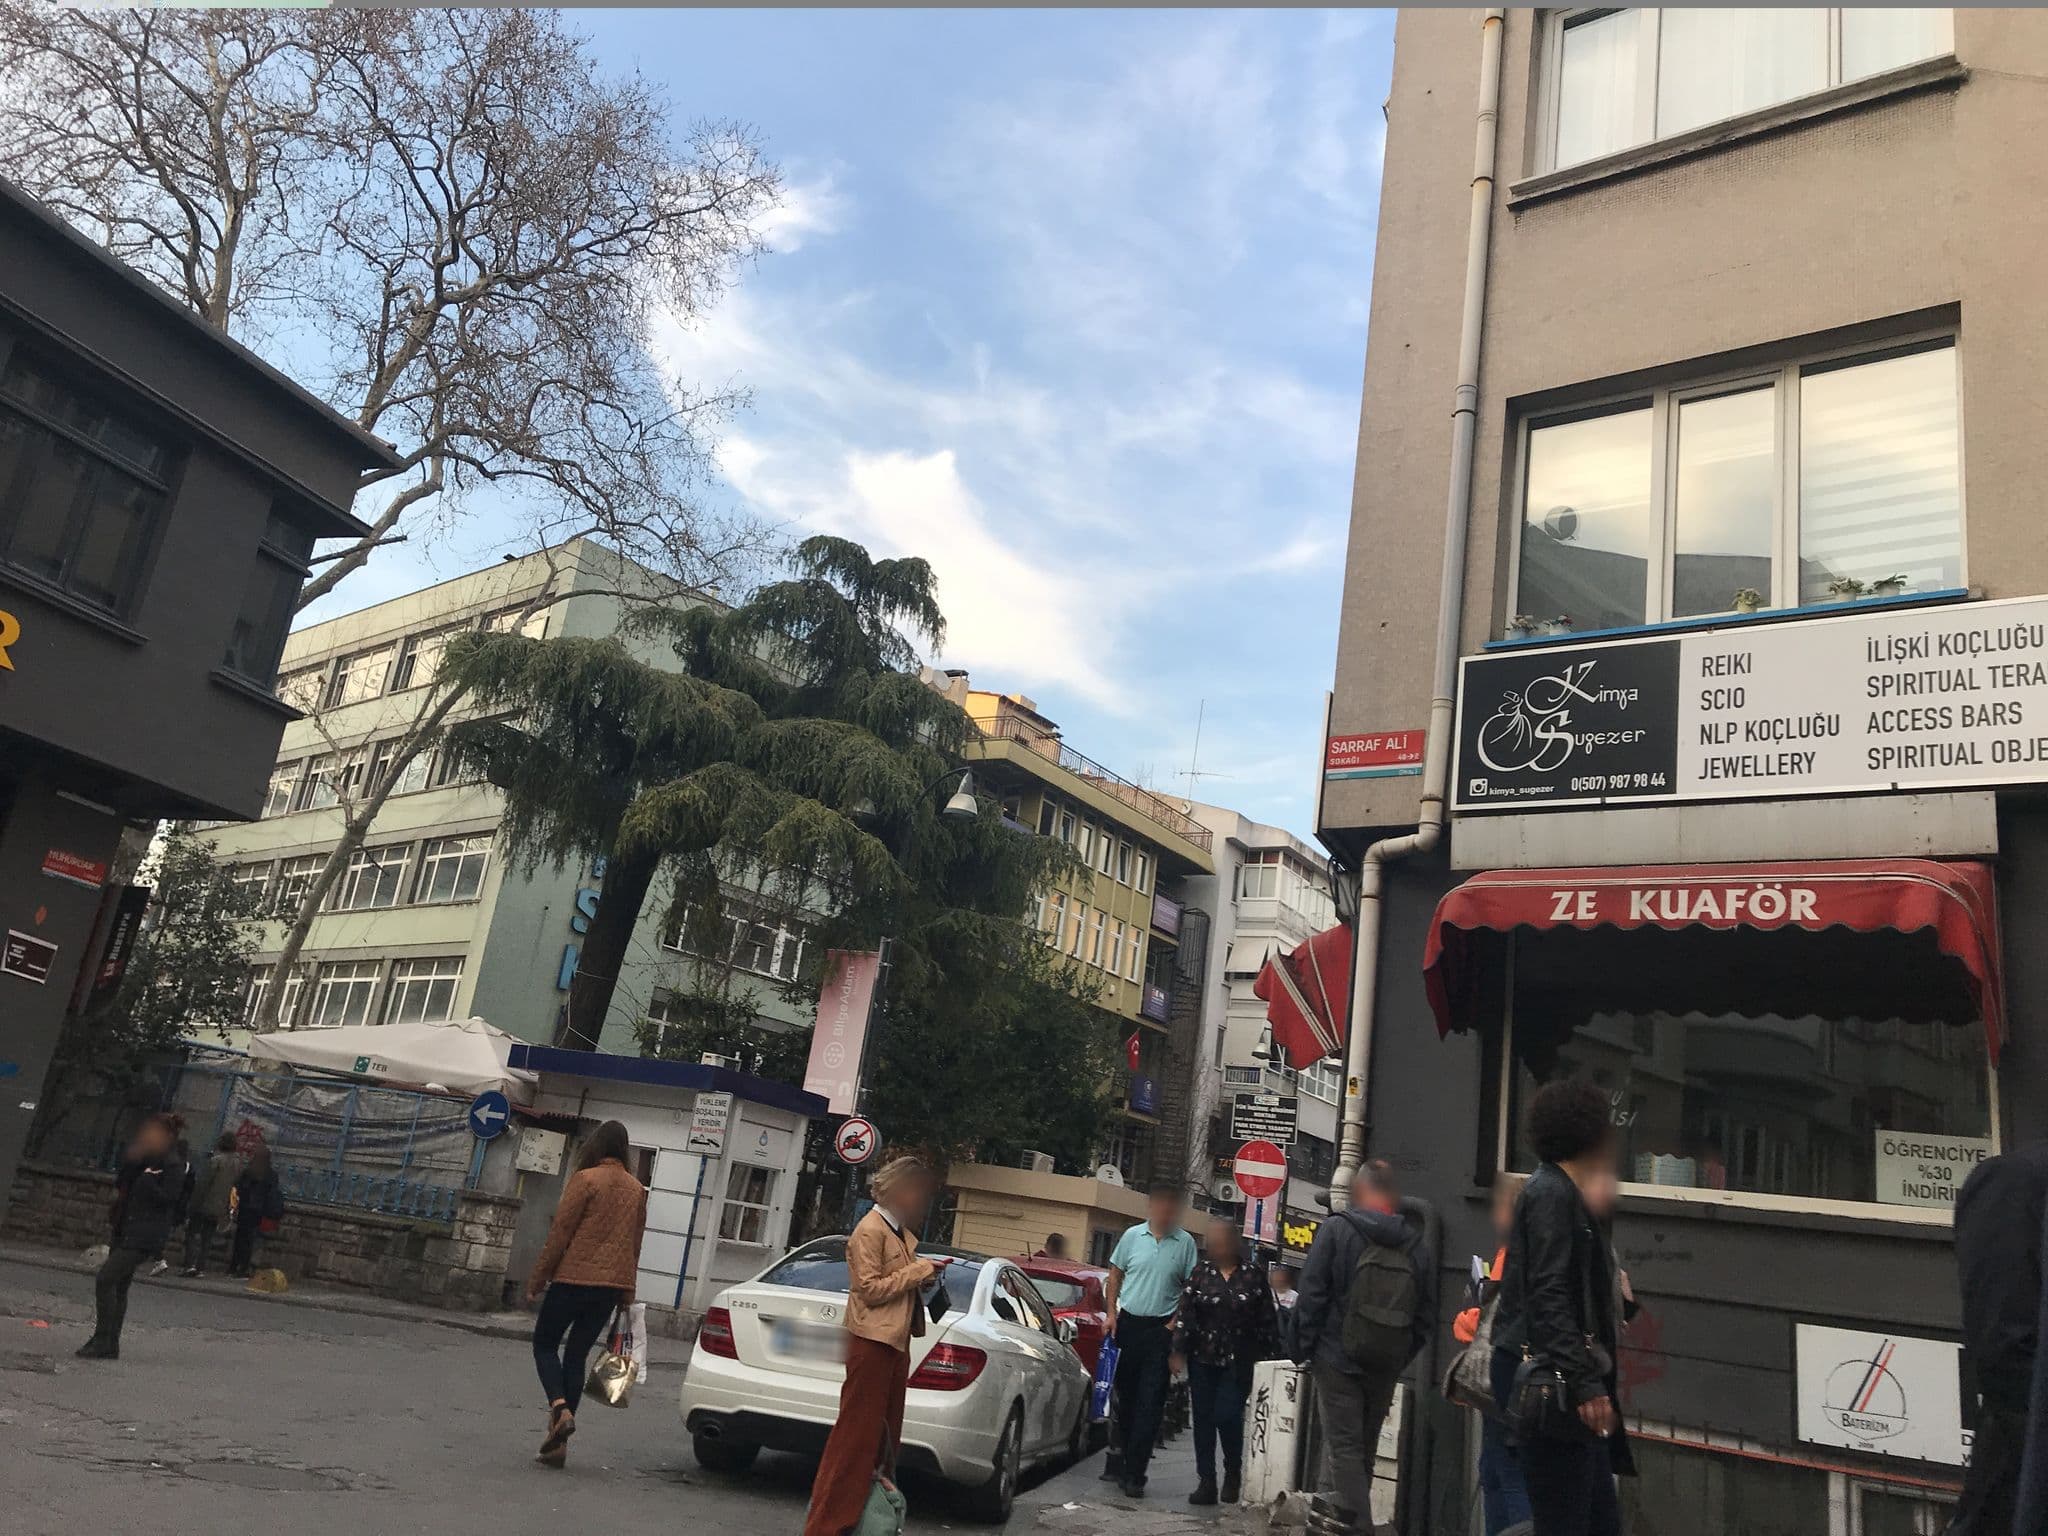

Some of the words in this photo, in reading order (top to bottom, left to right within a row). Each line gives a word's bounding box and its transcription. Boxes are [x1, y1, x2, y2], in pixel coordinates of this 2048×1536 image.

[1867, 631, 1929, 664] İLİŞKİ
[1938, 623, 2044, 658] KOÇLUĞU
[1702, 653, 1751, 677] REIKI
[1867, 668, 1981, 697] SPIRITUAL
[1700, 687, 1745, 711] SCIO
[1700, 722, 1737, 745] NLP
[1745, 712, 1840, 745] KOÇLUĞU
[1867, 707, 1952, 734] ACCESS
[1962, 702, 2022, 727] BARS
[1331, 738, 1382, 754] SARRAF
[1385, 734, 1408, 750] ALİ
[1867, 742, 1983, 770] SPIRITUAL
[1698, 752, 1816, 780] JEWELLERY
[1489, 785, 1554, 797] kimya_sugezer
[1571, 776, 1606, 791] 0(507)
[1609, 775, 1629, 789] 987
[1633, 774, 1648, 787] 98
[1651, 773, 1666, 787] 44
[1549, 891, 1598, 920] ZE
[1629, 883, 1820, 921] KUAFÖR
[1883, 1138, 1987, 1162] ÖĞRENCİYE
[1918, 1164, 1952, 1181] %30
